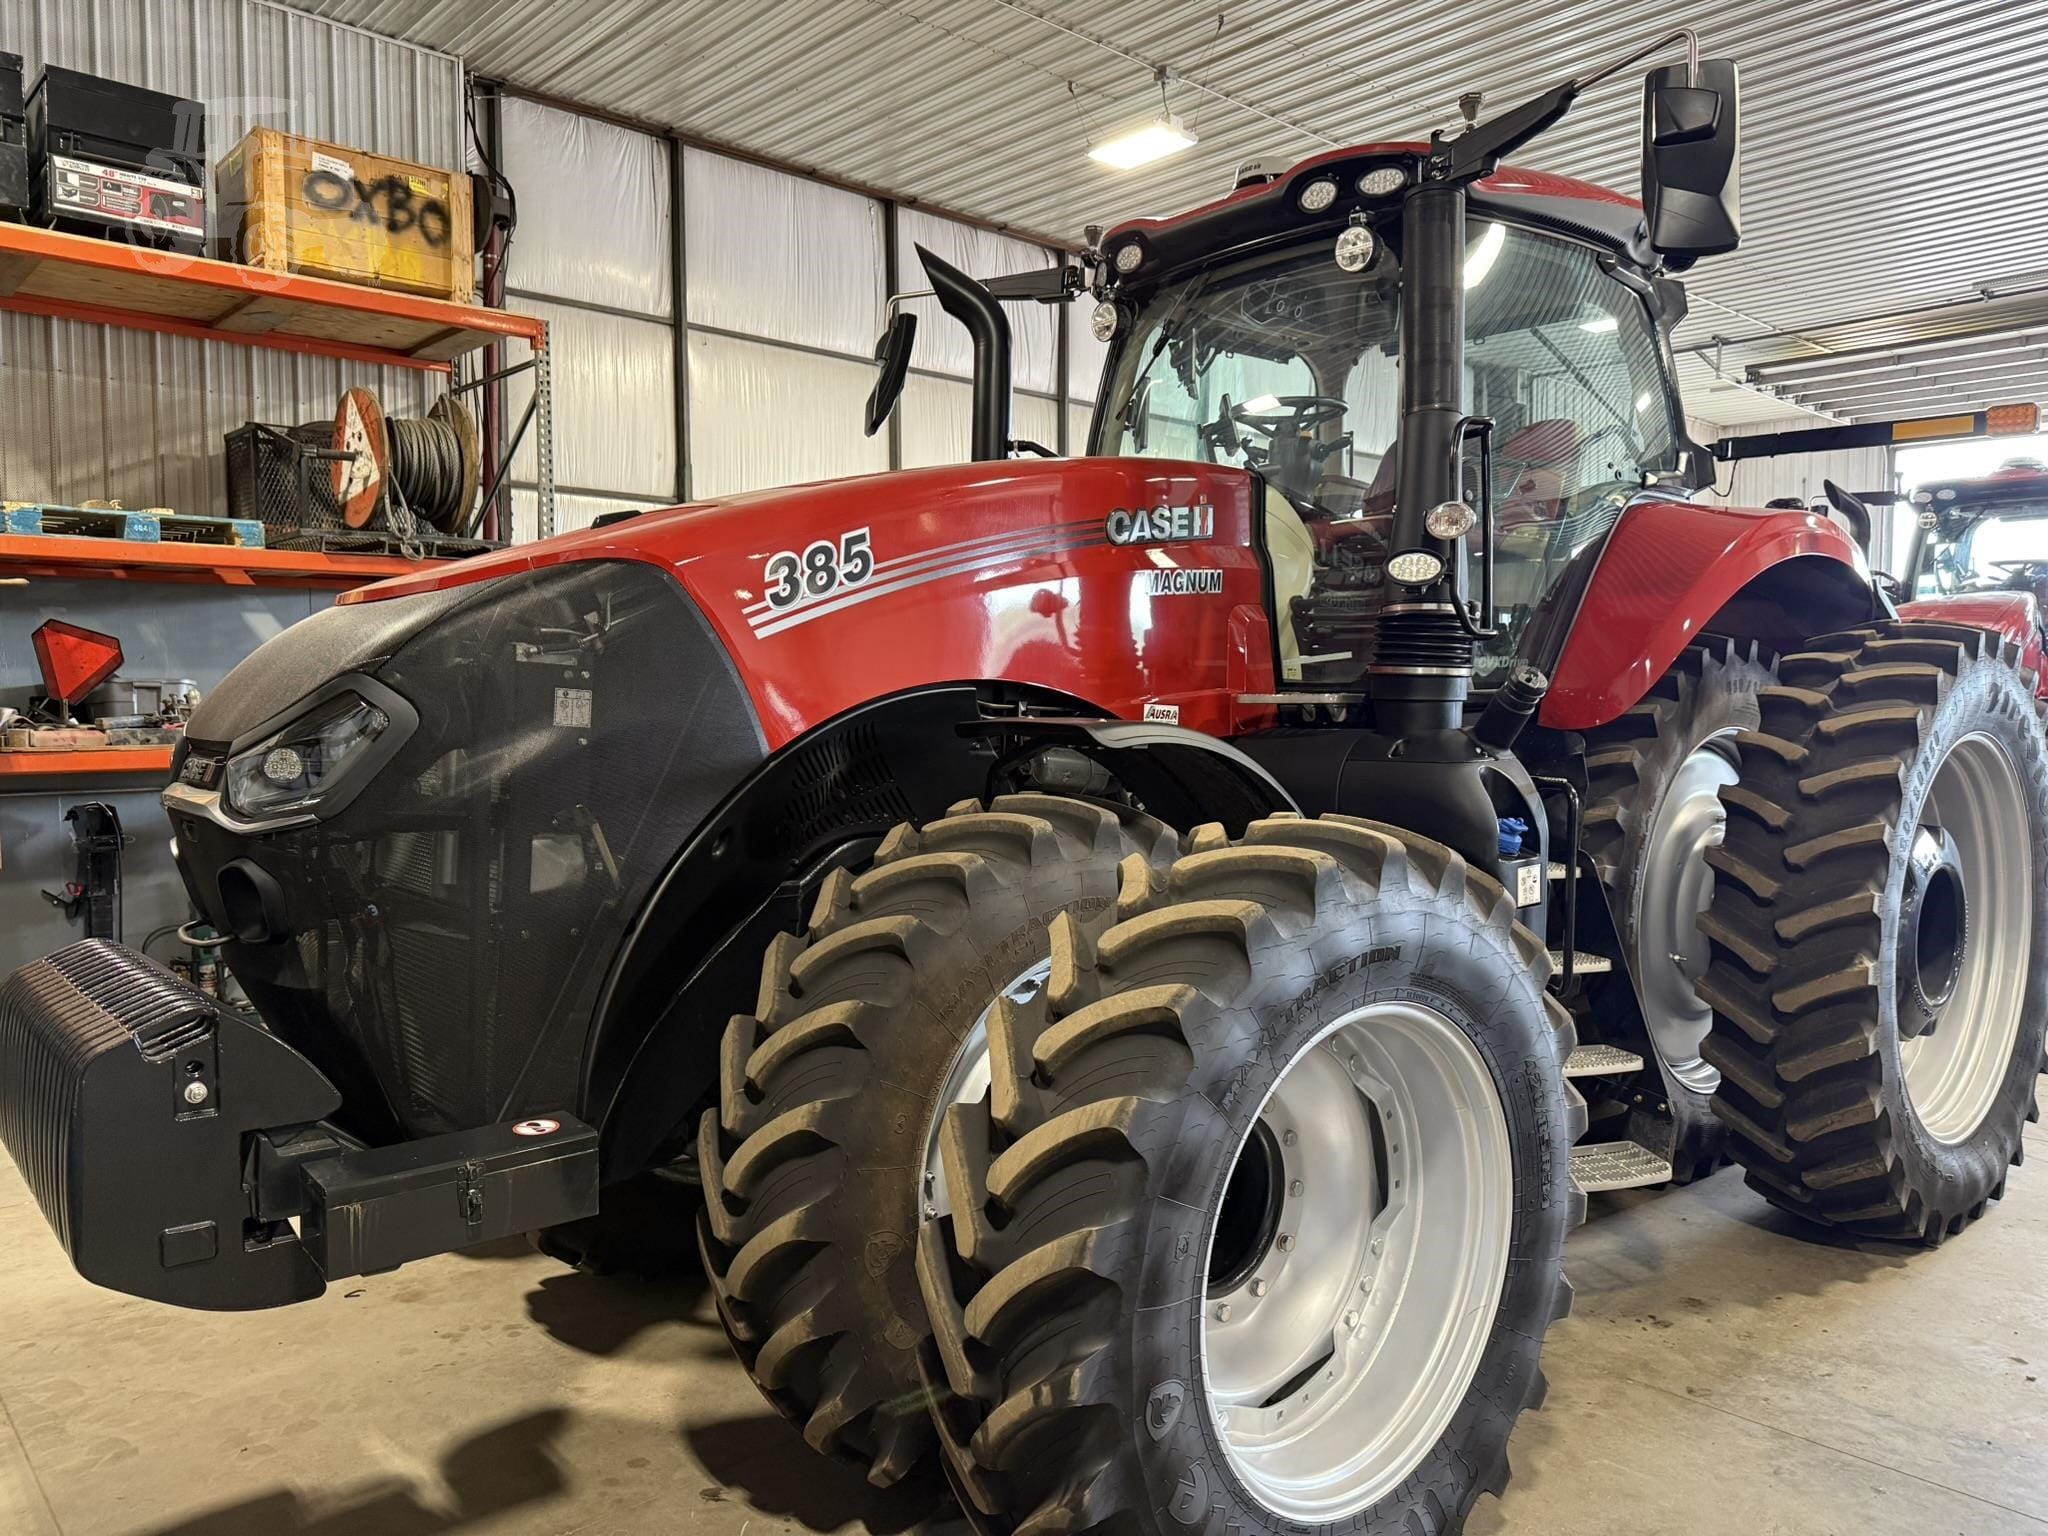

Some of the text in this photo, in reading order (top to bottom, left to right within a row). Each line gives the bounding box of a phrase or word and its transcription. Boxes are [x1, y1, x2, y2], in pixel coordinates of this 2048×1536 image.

[302, 168, 452, 247] OXBO
[1106, 505, 1190, 545] CASE
[764, 526, 875, 611] 385
[1146, 569, 1223, 596] MAGNUM
[1280, 944, 1402, 1024] TRACTION
